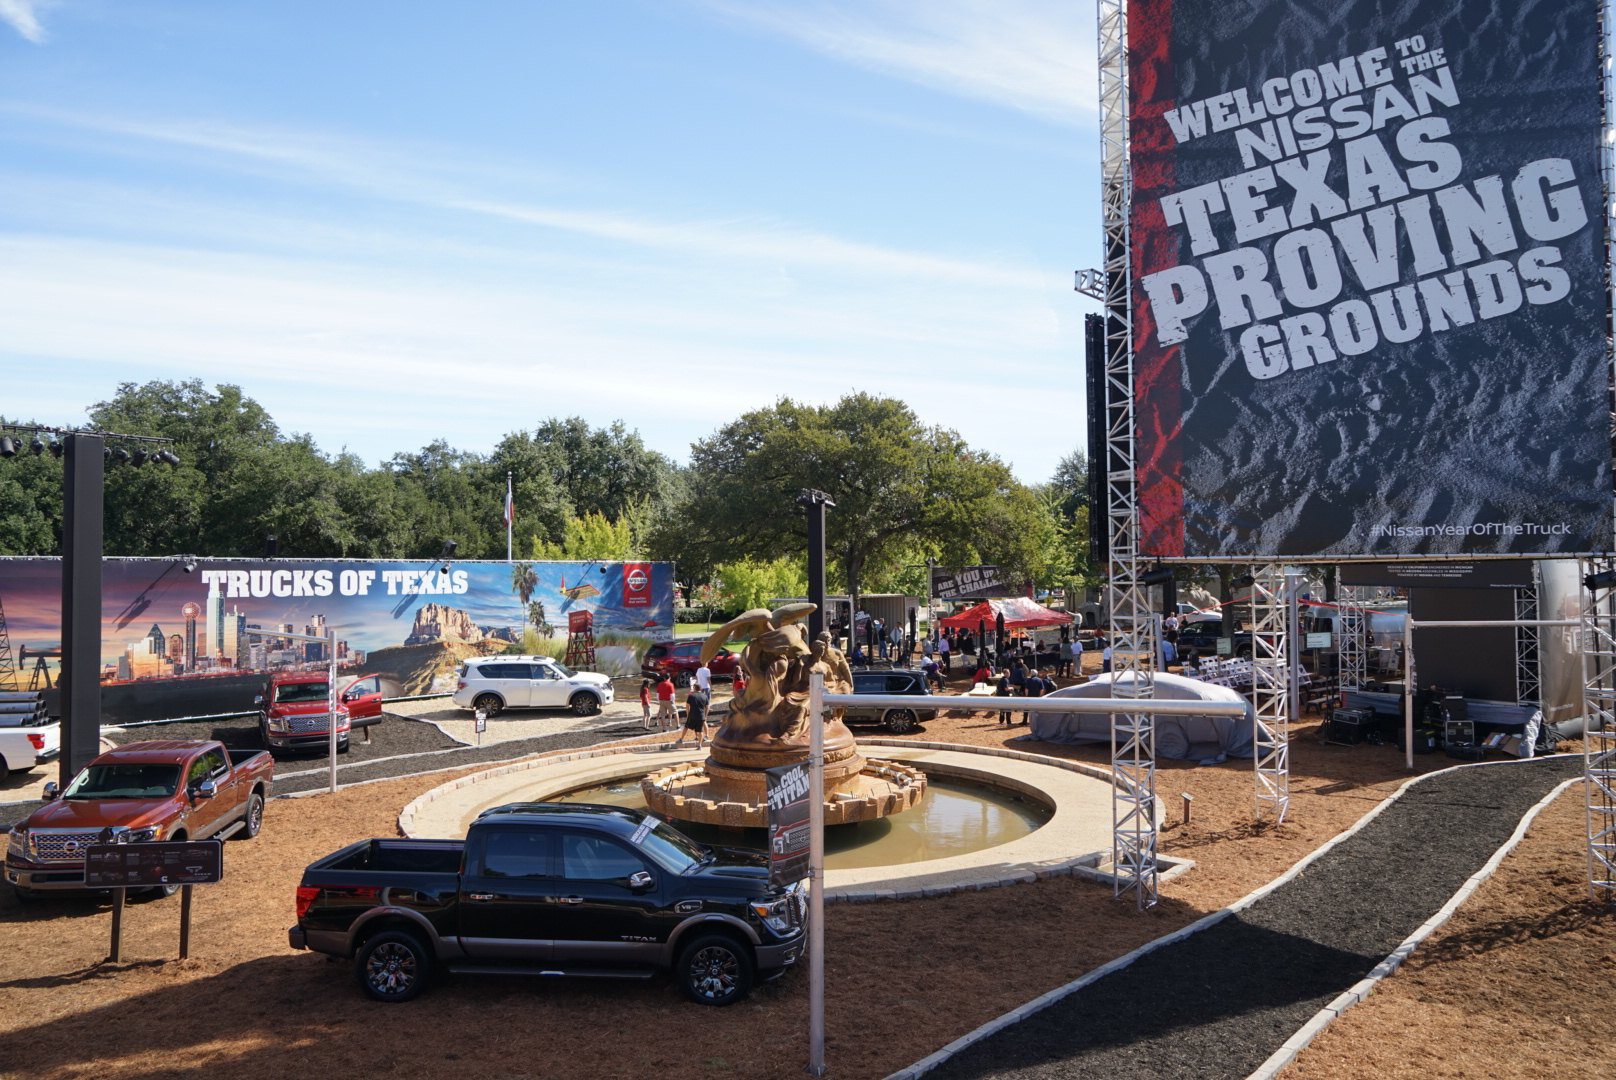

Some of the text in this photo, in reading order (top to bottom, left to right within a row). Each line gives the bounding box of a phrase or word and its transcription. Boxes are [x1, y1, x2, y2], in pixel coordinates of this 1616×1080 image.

[1395, 34, 1427, 58] TO
[1400, 47, 1447, 78] THE
[1163, 47, 1394, 144] WELCOME
[1234, 66, 1461, 169] NISSAN
[1160, 116, 1463, 256] TEXAS
[1141, 157, 1589, 348] PROVING
[1239, 246, 1571, 380] GROUNDS
[1370, 522, 1572, 537] #NissanYearOfTheTruck
[201, 570, 469, 598] TRUCKS OF TEXAS
[938, 569, 994, 590] ARE YOU UP
[940, 588, 957, 598] THE
[773, 772, 810, 810] TITAN
[780, 765, 804, 789] COOL
